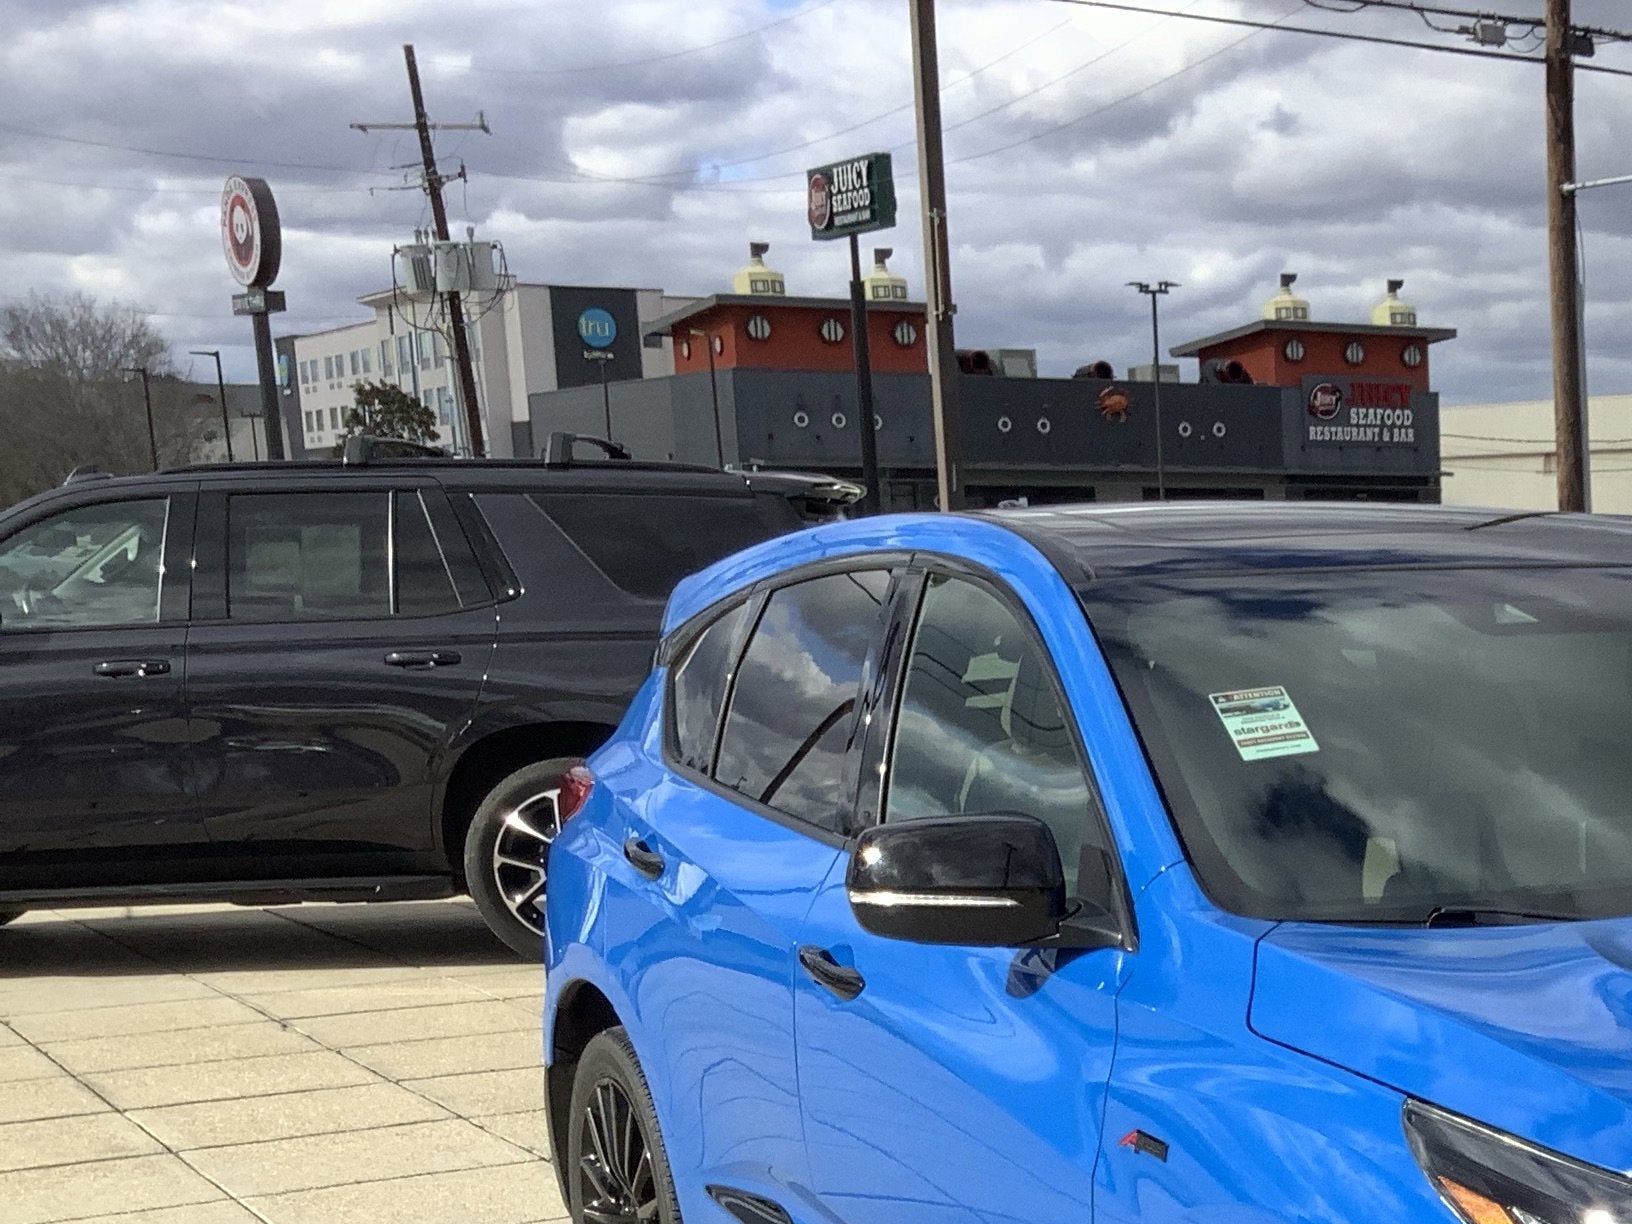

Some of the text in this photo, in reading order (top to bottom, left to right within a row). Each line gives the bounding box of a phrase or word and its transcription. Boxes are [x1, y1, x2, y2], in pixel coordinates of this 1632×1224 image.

[831, 160, 869, 194] JUICY
[831, 188, 871, 213] SEAFOOD
[1345, 383, 1411, 407] JUICY
[1350, 407, 1413, 426] SEAFOOD
[1309, 426, 1415, 442] RESTAURANT & BAR
[1233, 689, 1282, 701] ATTENTION
